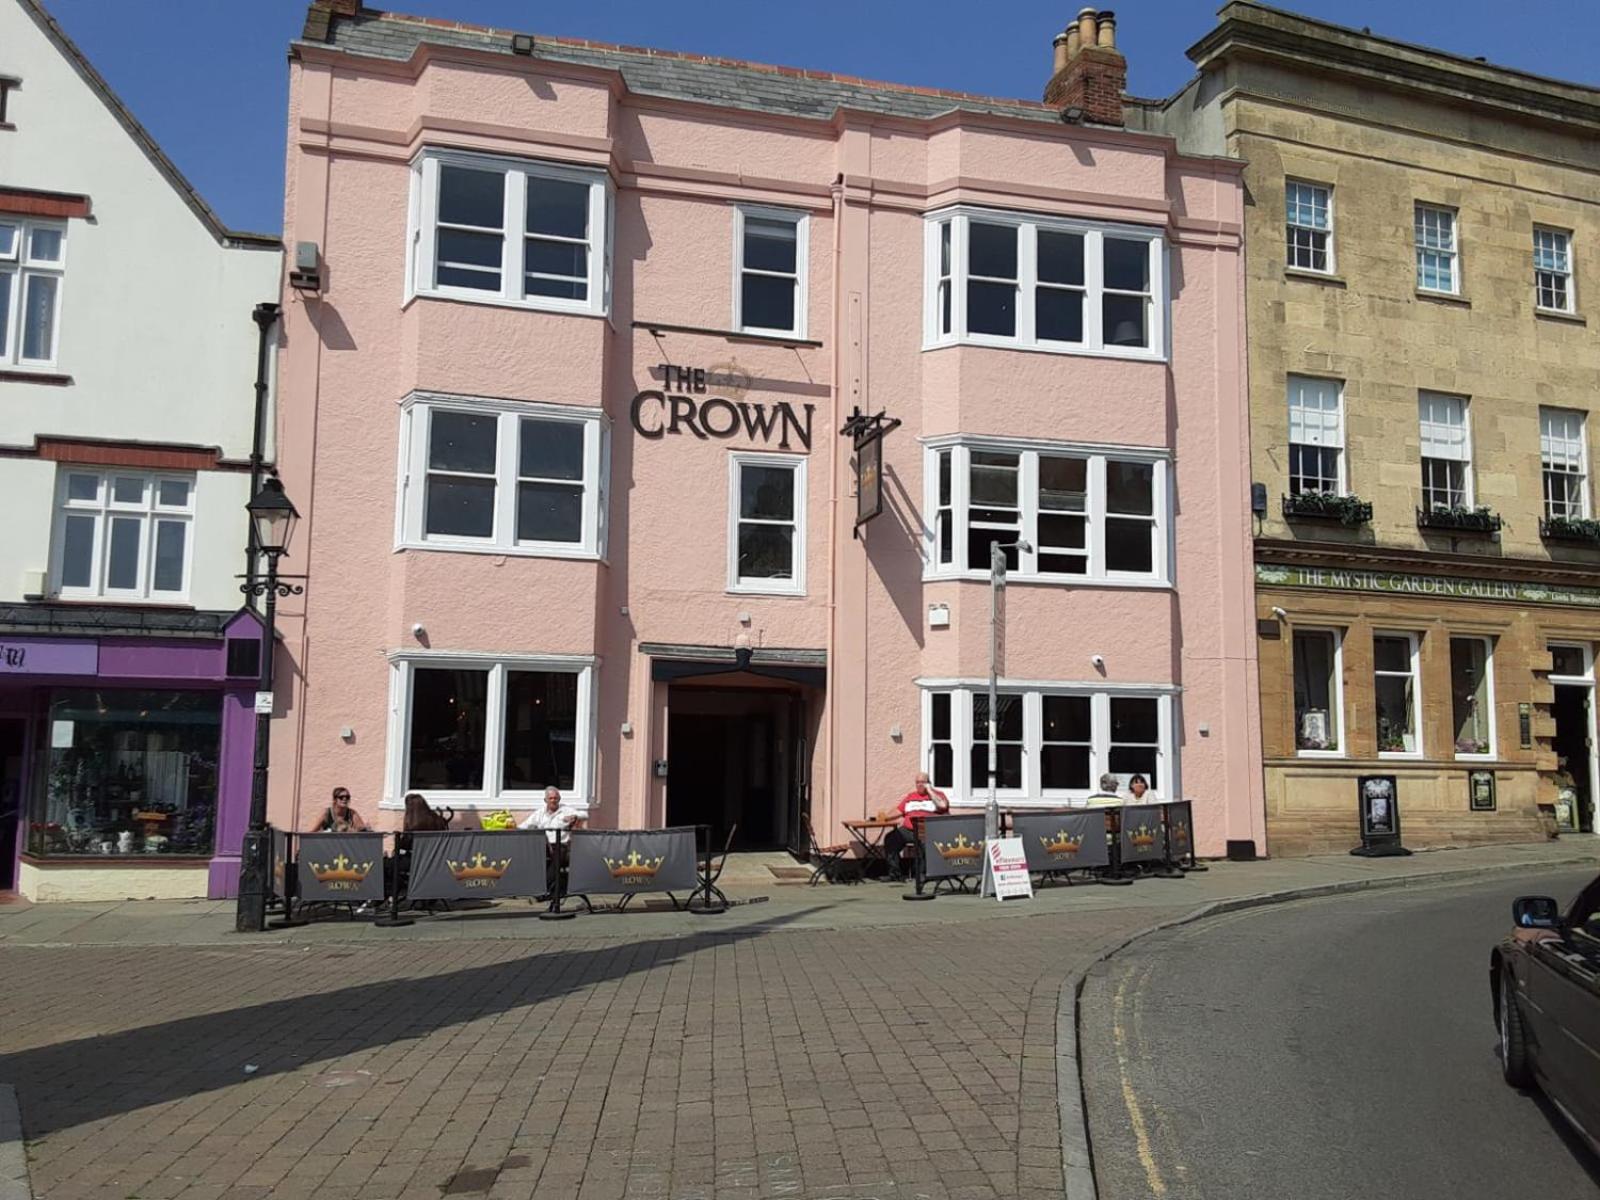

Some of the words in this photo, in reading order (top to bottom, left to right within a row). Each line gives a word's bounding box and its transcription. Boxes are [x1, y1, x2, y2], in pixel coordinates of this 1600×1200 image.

[658, 364, 706, 394] THE
[630, 390, 814, 451] CROWN
[1298, 569, 1327, 586] THE
[1331, 571, 1386, 590] MYSTIC
[1389, 575, 1456, 594] GARDEN
[1459, 580, 1518, 598] GALLERY
